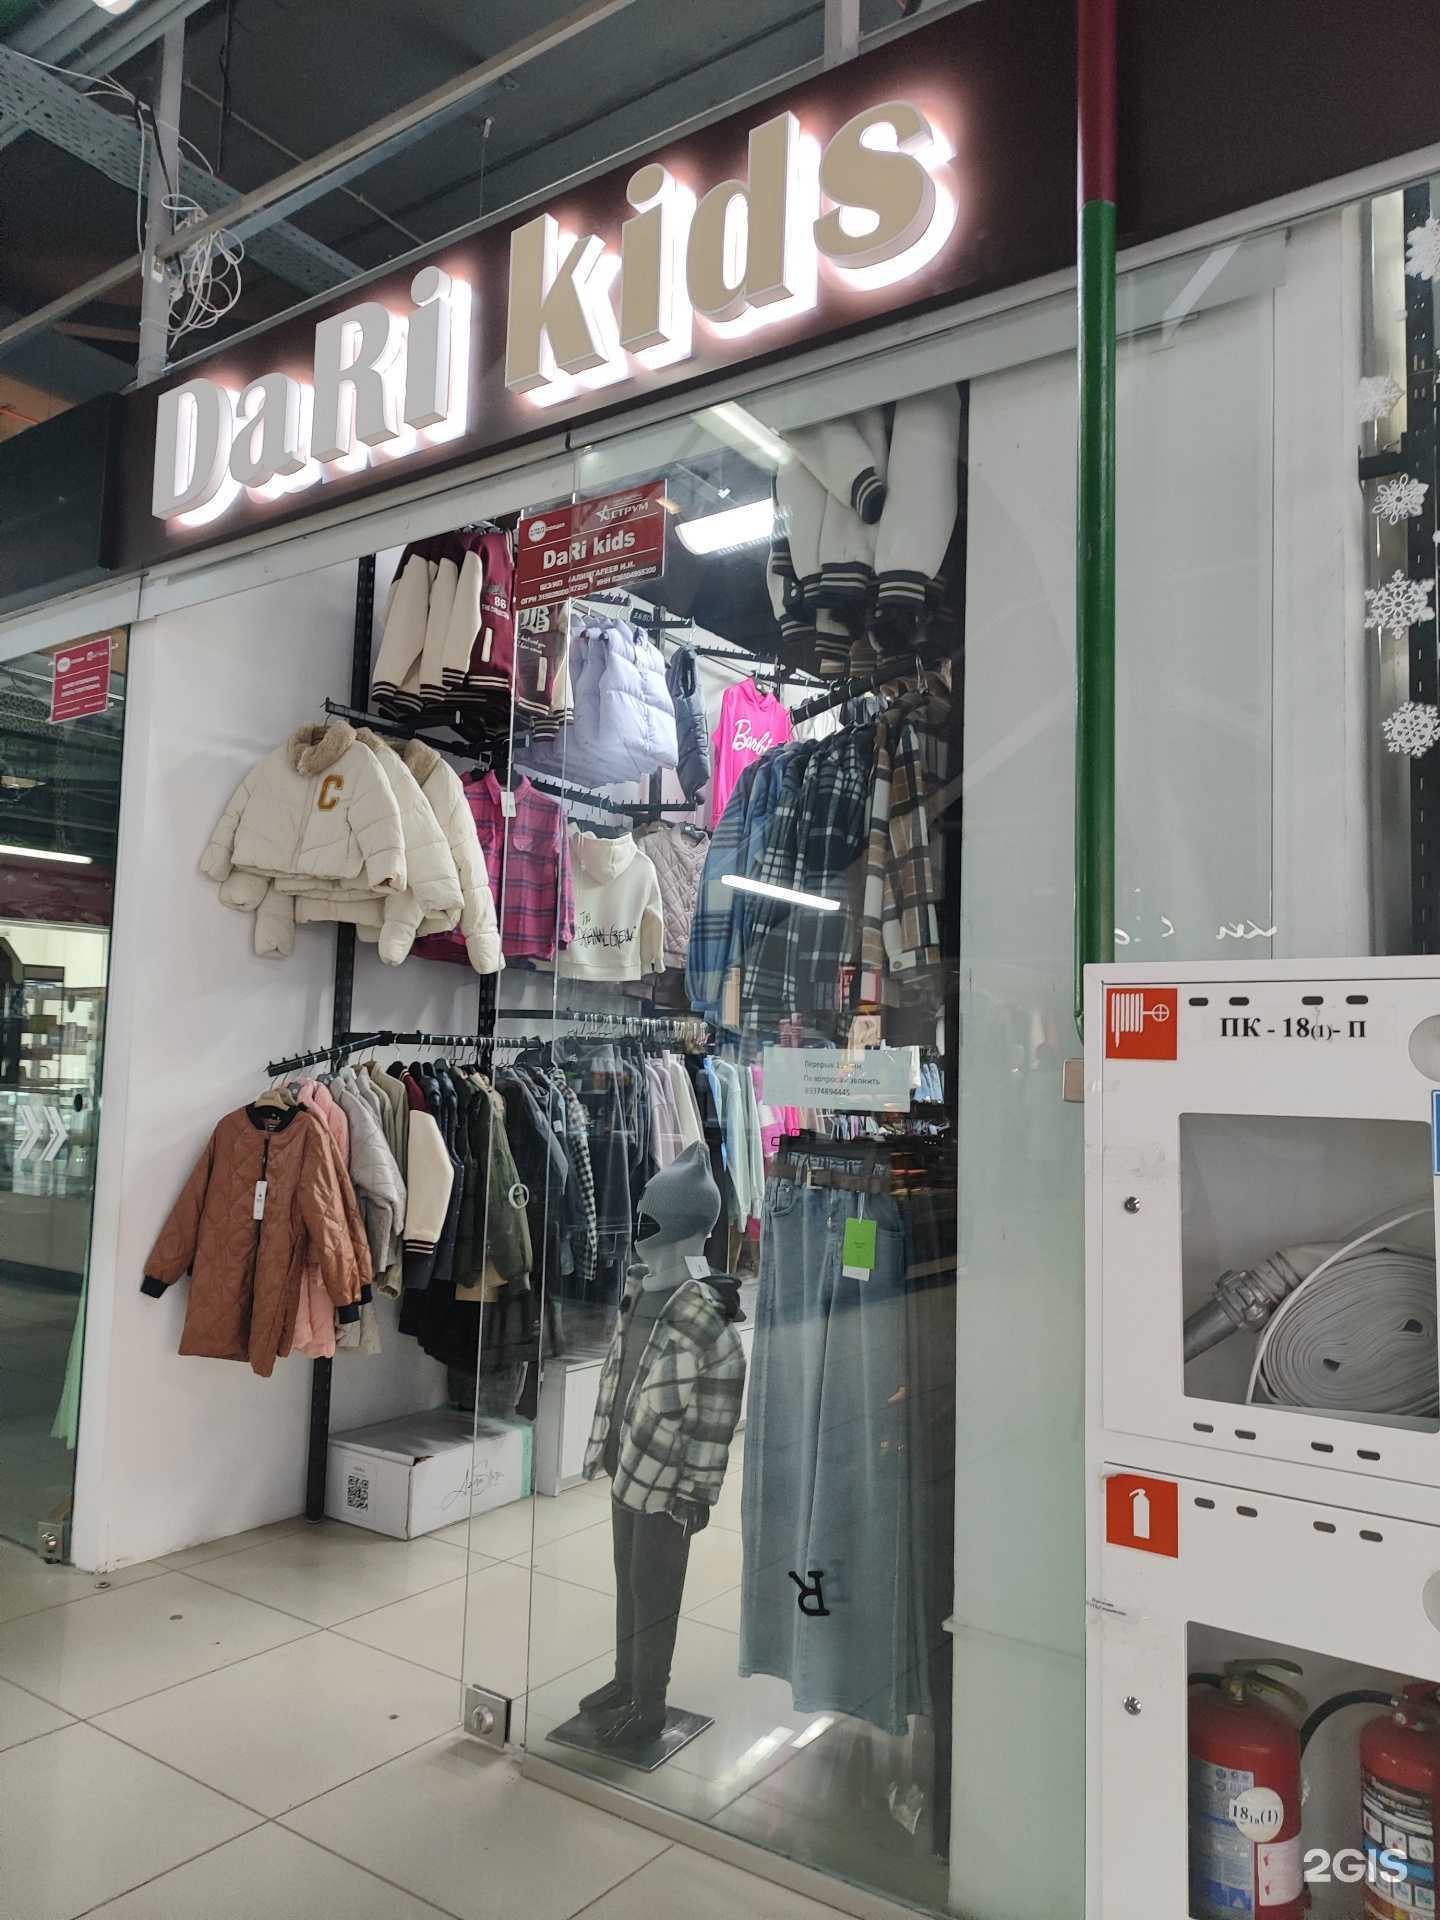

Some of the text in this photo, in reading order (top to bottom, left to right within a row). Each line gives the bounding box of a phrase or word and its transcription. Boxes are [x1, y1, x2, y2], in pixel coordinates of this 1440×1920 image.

[153, 100, 945, 523] DaRi kids
[542, 539, 587, 570] DaRi
[593, 530, 636, 557] kids
[732, 718, 774, 756] Barbi
[318, 773, 344, 812] C
[1220, 1017, 1261, 1038] ПК
[1349, 1020, 1367, 1038] П
